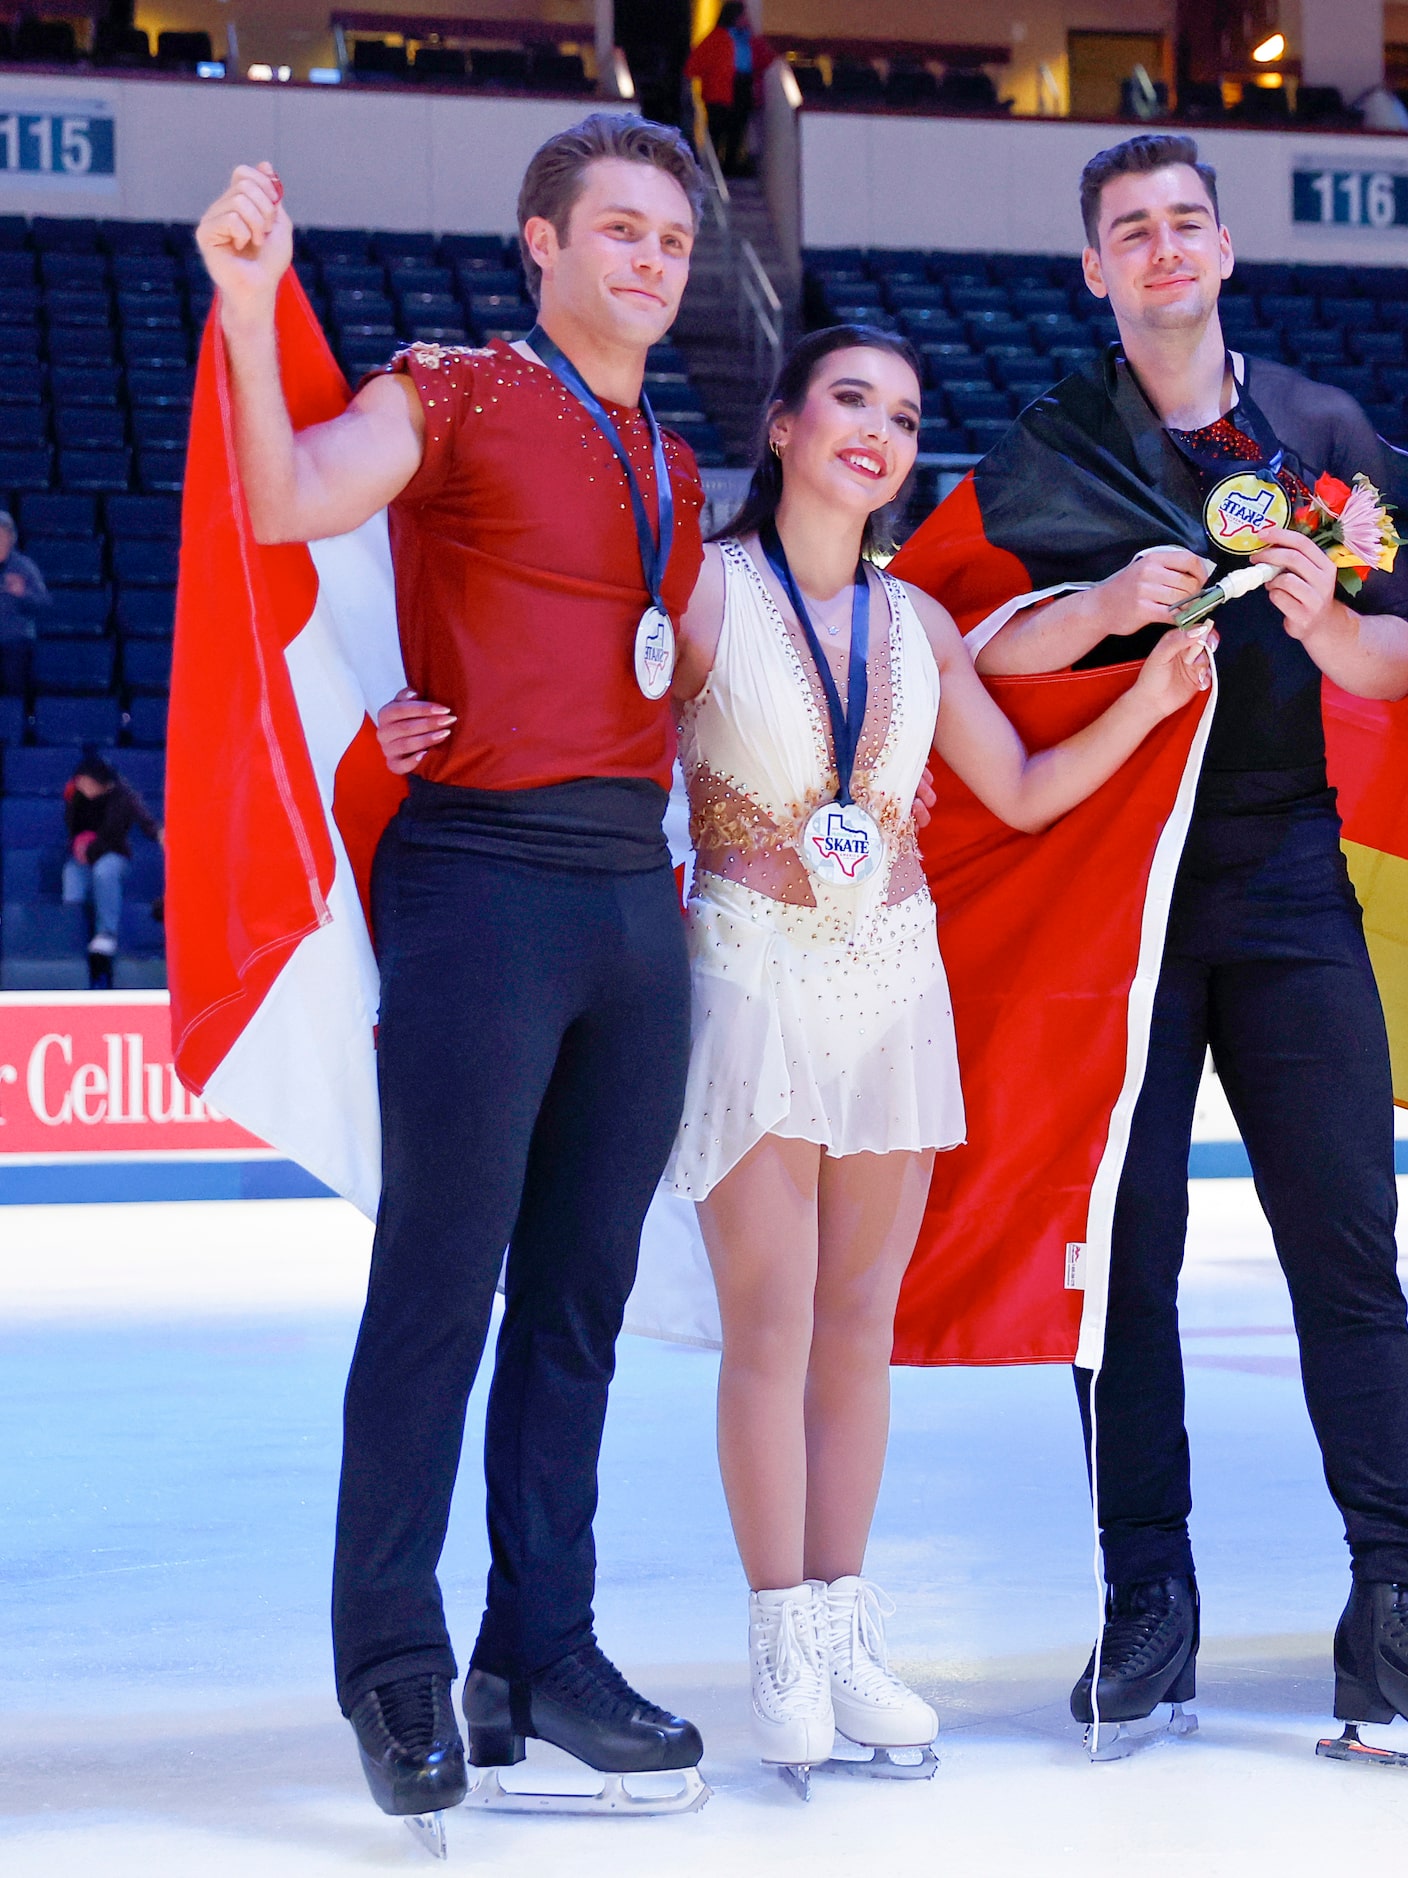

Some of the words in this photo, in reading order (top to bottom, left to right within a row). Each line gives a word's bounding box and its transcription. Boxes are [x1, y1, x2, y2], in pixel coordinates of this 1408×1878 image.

[0, 116, 92, 172] 115
[1311, 173, 1396, 225] 116
[825, 837, 869, 854] SKATE
[27, 1033, 229, 1125] Cellu
